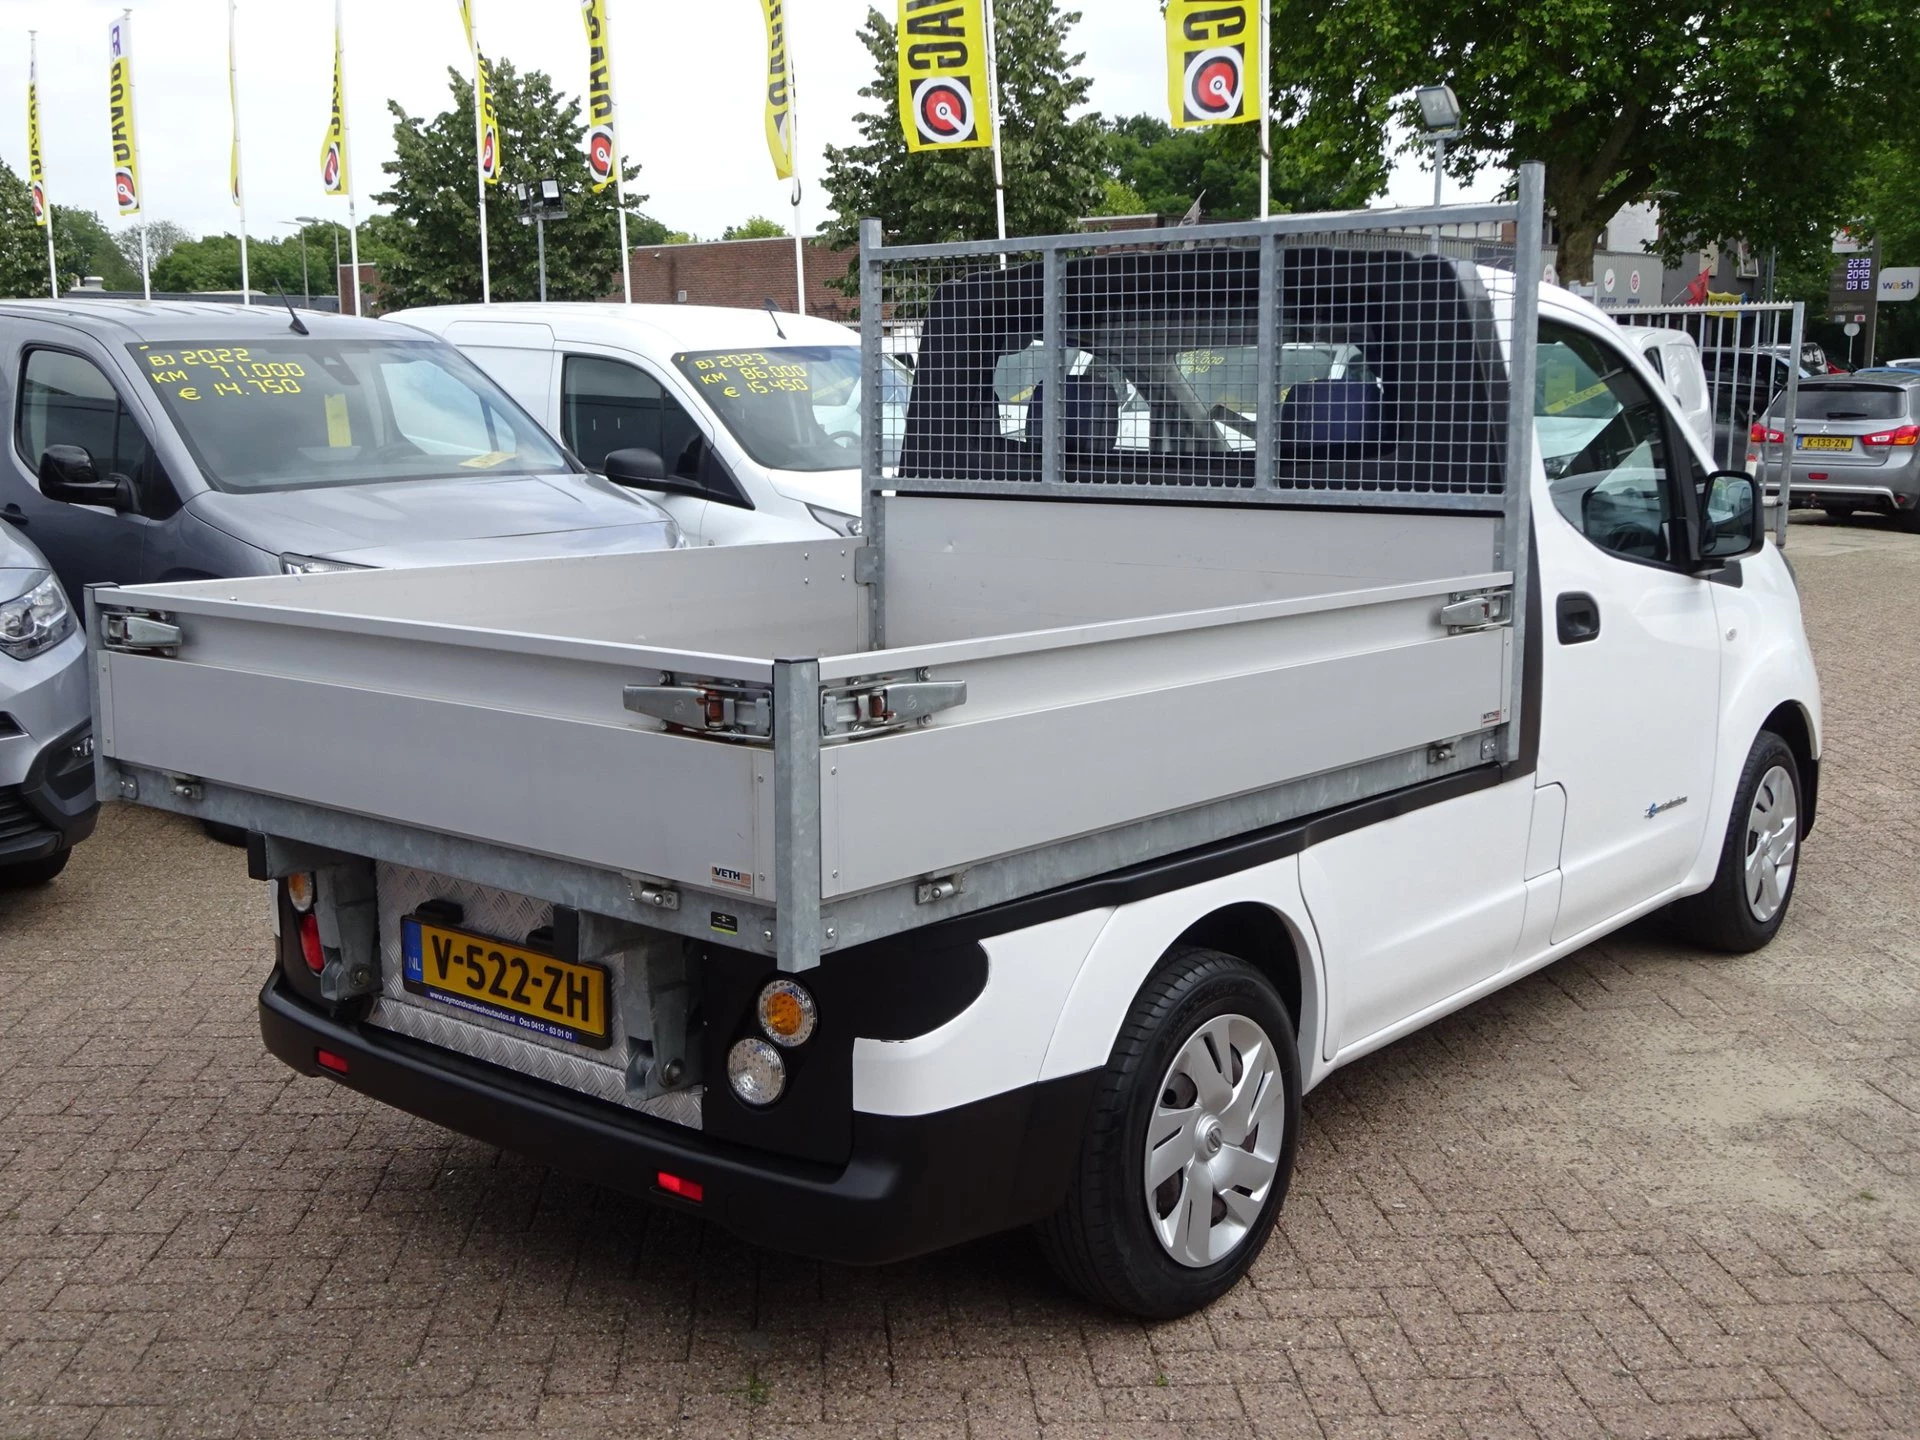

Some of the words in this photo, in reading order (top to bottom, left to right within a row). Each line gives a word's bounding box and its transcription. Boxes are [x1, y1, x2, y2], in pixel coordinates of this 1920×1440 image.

[1883, 280, 1913, 290] wash
[180, 348, 251, 365] 2022
[716, 353, 768, 368] 2023
[152, 370, 189, 384] KM
[210, 362, 305, 378] 71.000
[700, 372, 728, 385] KM
[739, 365, 808, 380] 86.000
[178, 387, 201, 400] €
[213, 379, 301, 396] 14.750
[723, 386, 741, 397] €
[746, 379, 808, 393] 15.450
[1807, 438, 1847, 447] K-133-ZN
[714, 867, 740, 880] VETH
[408, 957, 421, 972] NL
[431, 934, 589, 1022] V-522-ZH
[519, 1017, 530, 1028] Oss
[531, 1021, 545, 1032] 0412
[557, 1029, 564, 1037] 01
[565, 1031, 572, 1039] 01
